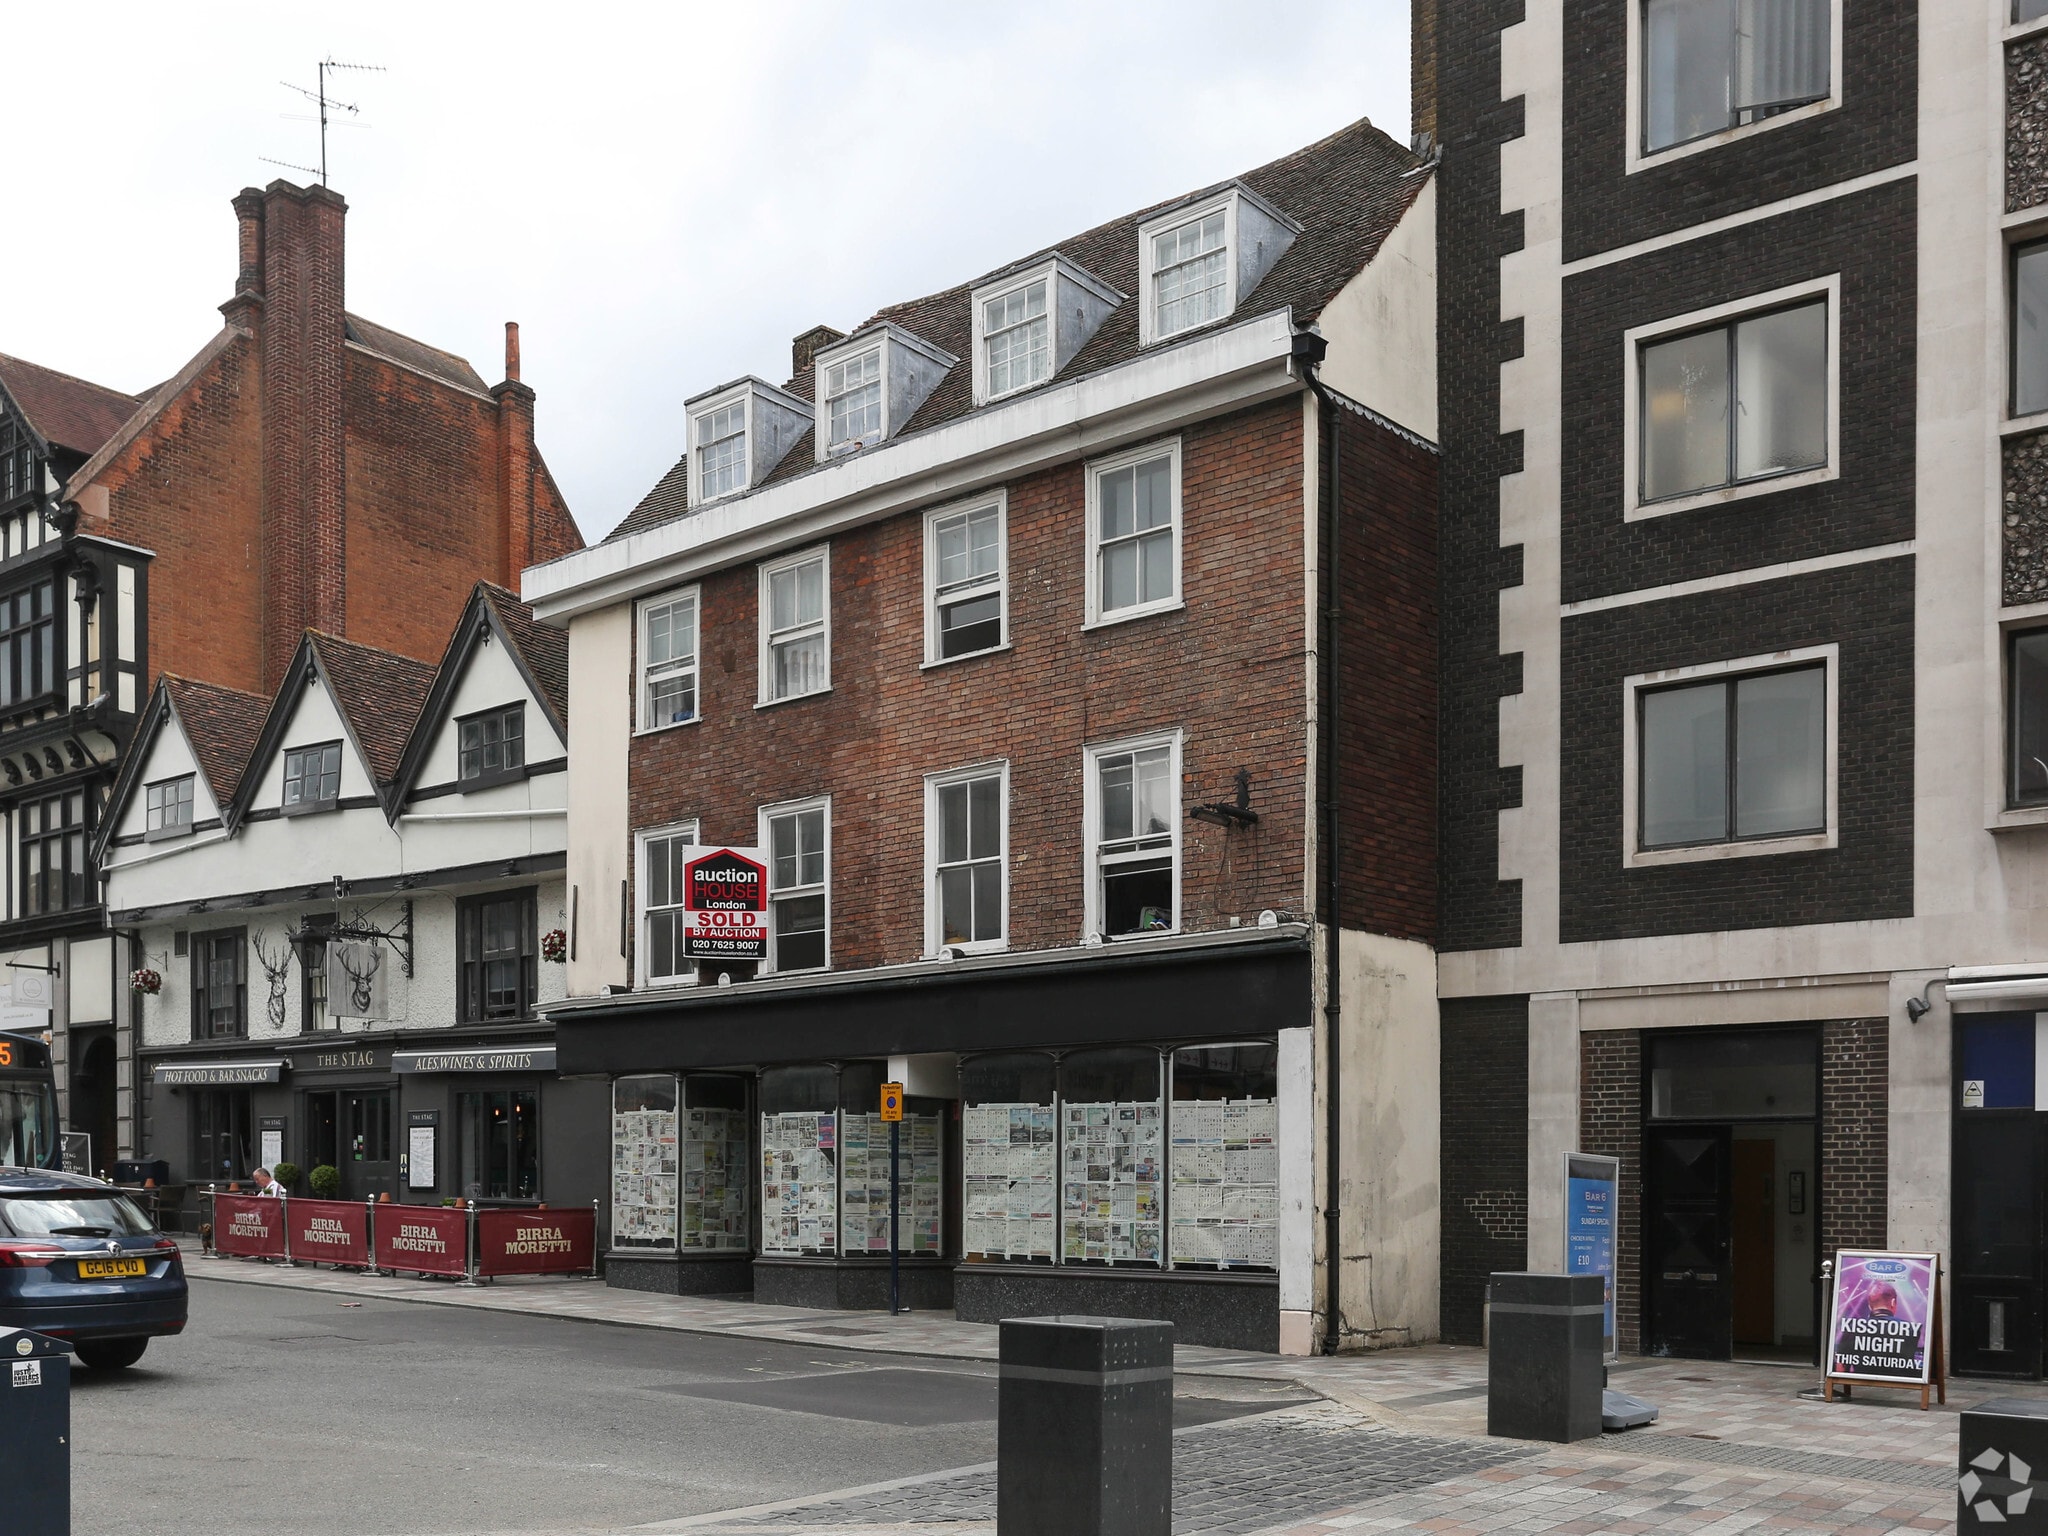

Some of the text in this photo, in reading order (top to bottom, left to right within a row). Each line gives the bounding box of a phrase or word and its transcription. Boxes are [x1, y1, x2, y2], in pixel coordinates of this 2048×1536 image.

[694, 868, 758, 883] auction
[695, 882, 758, 899] HOUSE
[706, 899, 746, 910] London
[697, 911, 756, 927] SOLD
[693, 927, 760, 937] BY AUCTION
[692, 939, 760, 950] 020 7625 9007
[0, 1042, 12, 1066] 5
[317, 1050, 374, 1067] THE STAG
[476, 1056, 486, 1069] &
[489, 1053, 532, 1069] SPIRITS
[164, 1068, 268, 1082] HOT FOOD & BAR SNACKS
[1585, 1191, 1607, 1202] BAR 6
[234, 1212, 262, 1226] BIRRA
[311, 1217, 343, 1232] BIRRA
[229, 1223, 268, 1238] MORETTI
[304, 1229, 351, 1245] MORETTI
[400, 1224, 438, 1239] BIRRA
[516, 1227, 563, 1241] BIRRA
[392, 1236, 446, 1253] MORETTI
[505, 1239, 572, 1255] MORETTI
[1577, 1254, 1590, 1266] £10
[1869, 1262, 1903, 1272] BAR 6
[86, 1262, 114, 1275] GC16
[1841, 1317, 1922, 1337] KISSTORY
[1854, 1335, 1905, 1353] NIGHT
[1835, 1353, 1923, 1370] THIS SATURDAY
